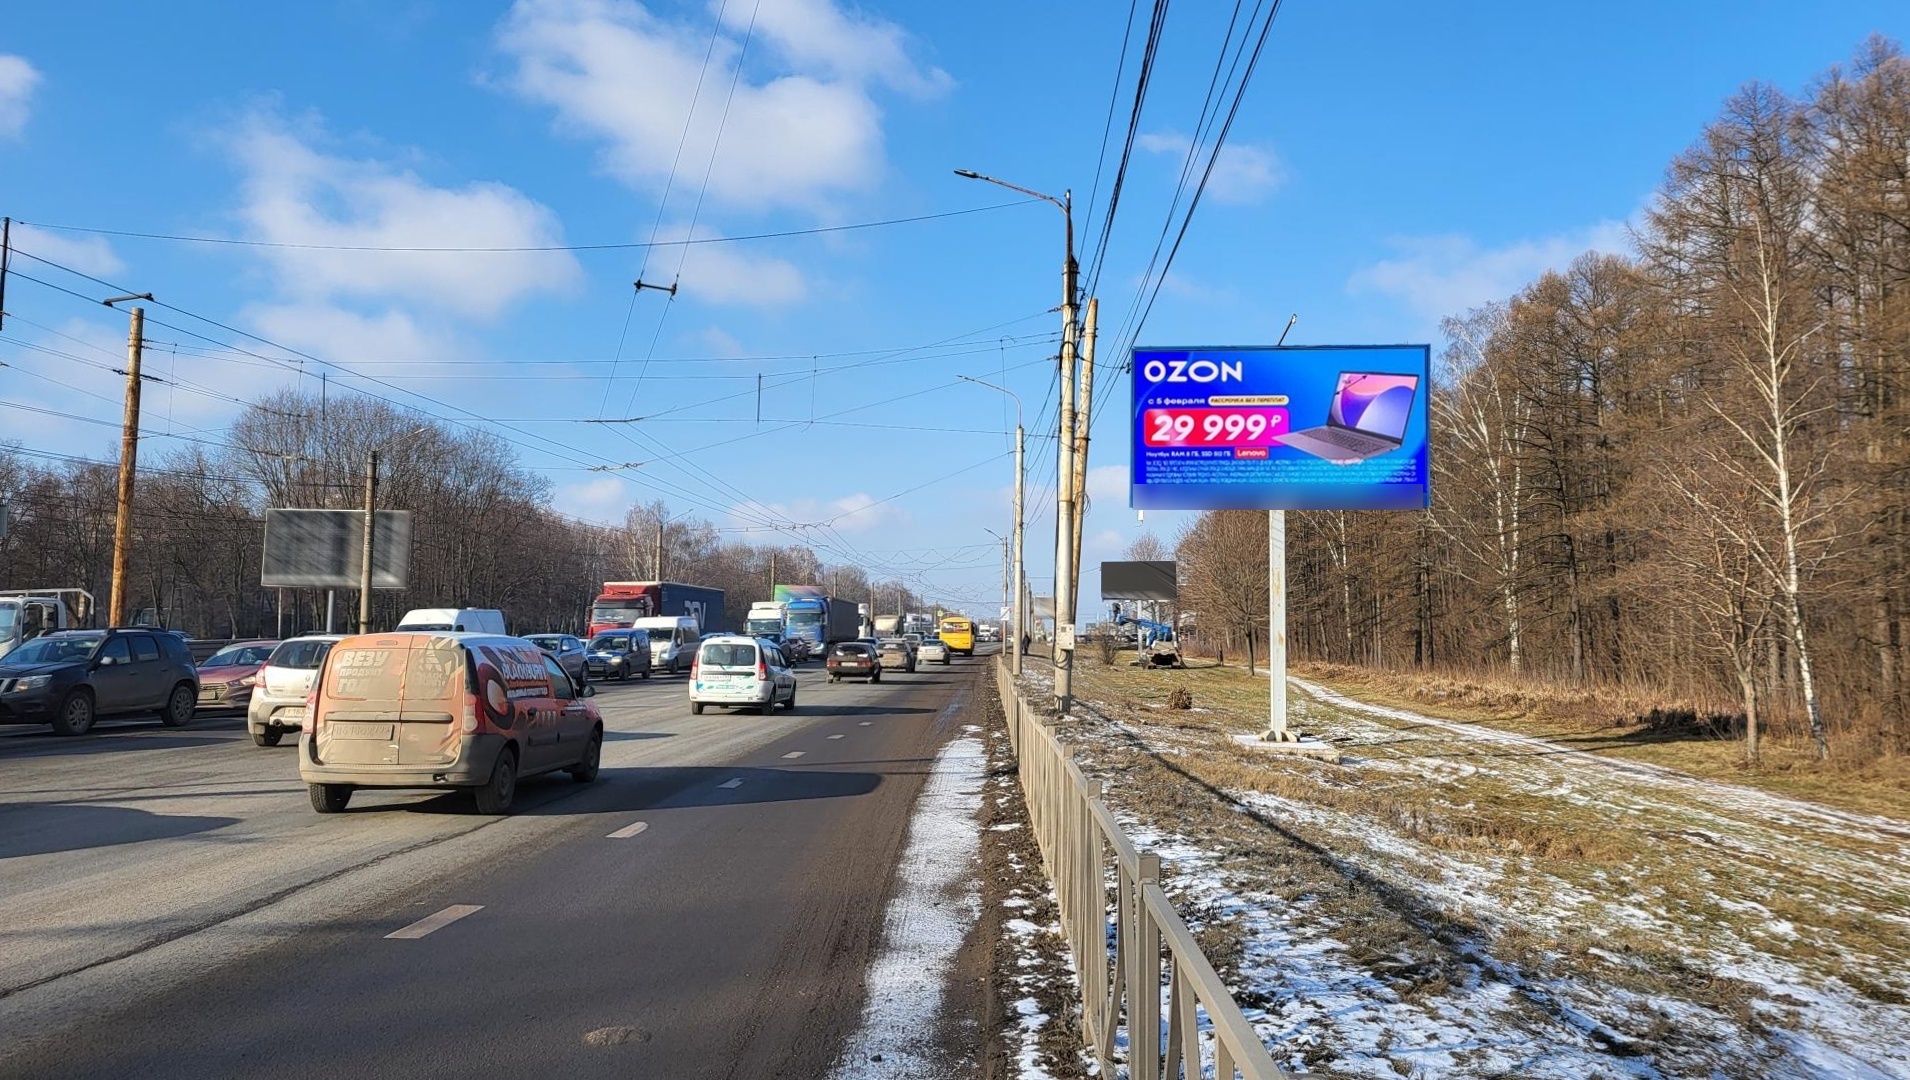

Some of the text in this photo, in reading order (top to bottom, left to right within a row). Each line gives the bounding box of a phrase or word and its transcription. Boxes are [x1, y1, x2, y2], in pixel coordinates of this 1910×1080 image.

[1144, 360, 1242, 383] OZON
[1164, 397, 1206, 406] февраля
[1151, 414, 1195, 441] 29
[1203, 414, 1267, 441] 999
[1237, 449, 1266, 457] Lenovo
[341, 651, 390, 667] ВЕЗУ
